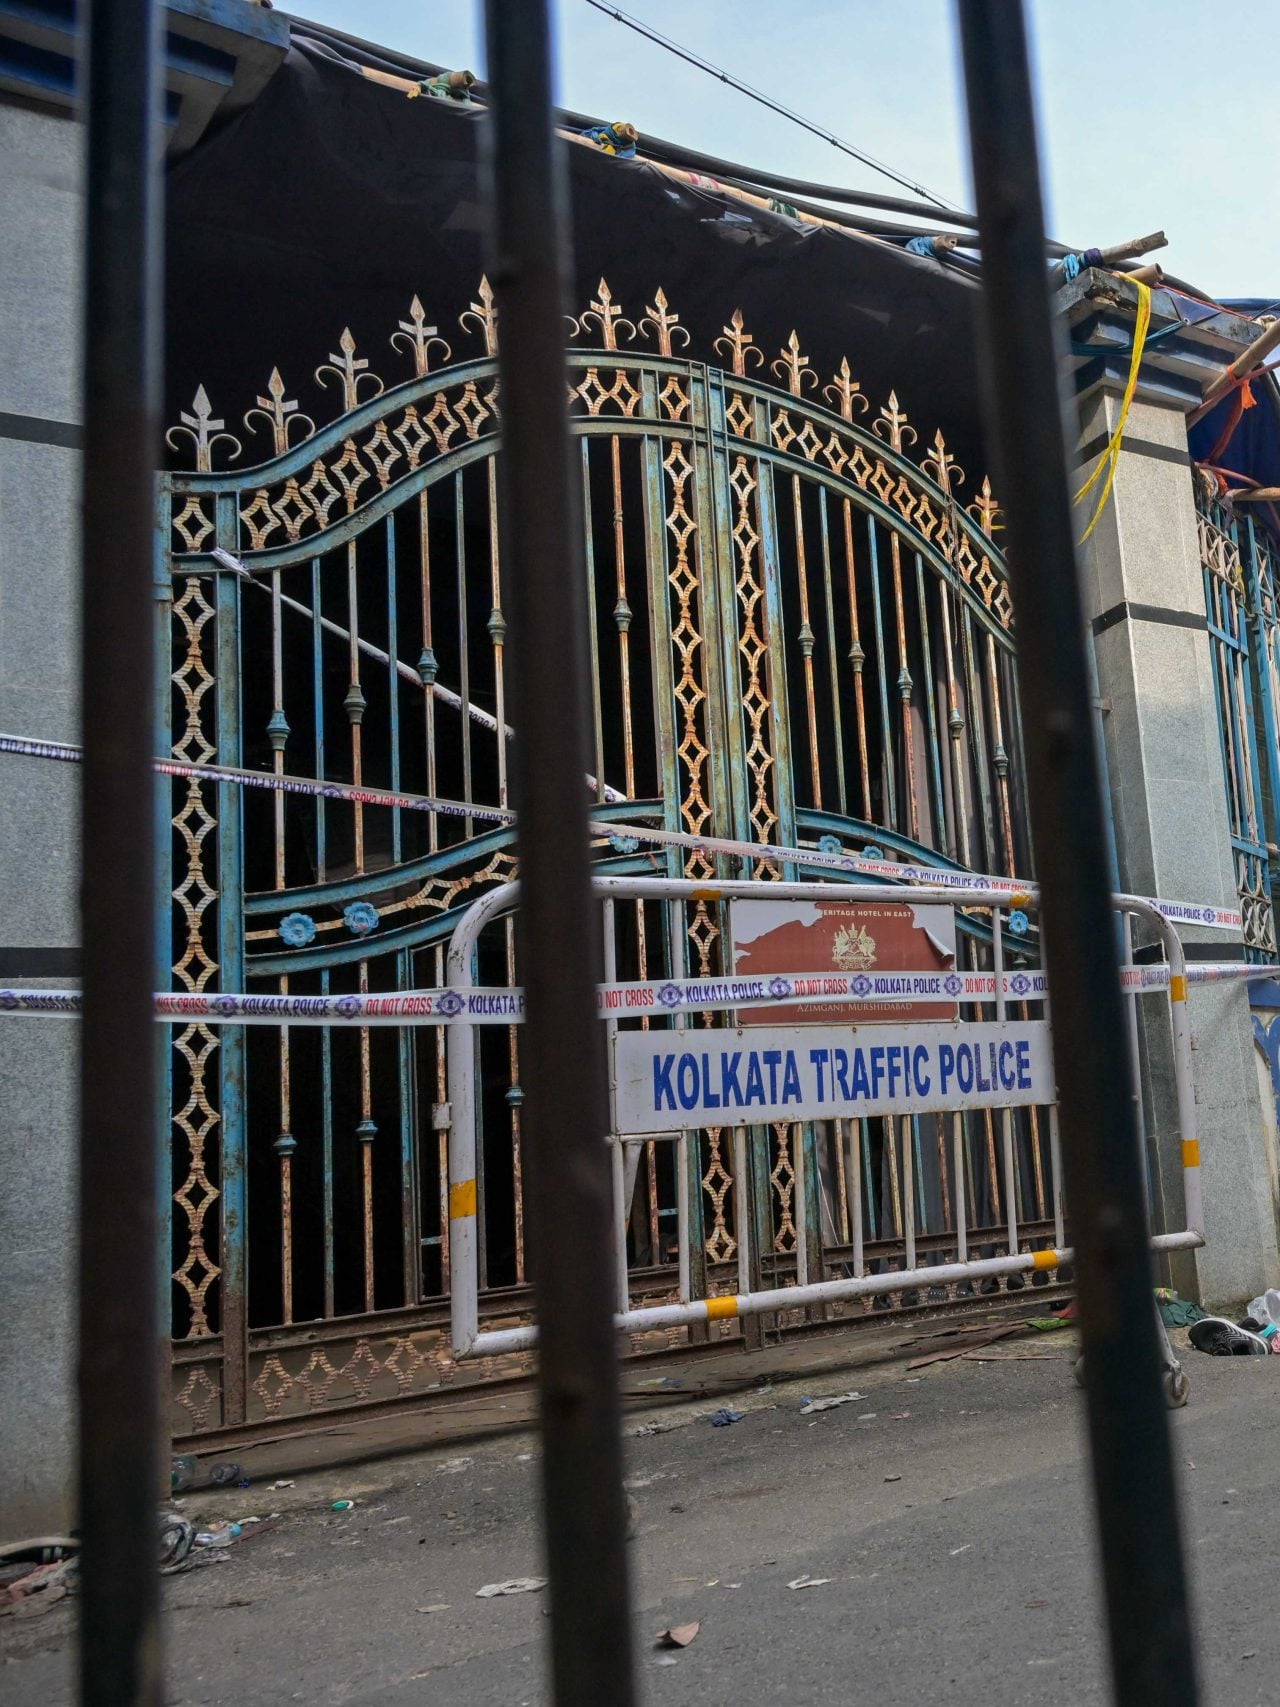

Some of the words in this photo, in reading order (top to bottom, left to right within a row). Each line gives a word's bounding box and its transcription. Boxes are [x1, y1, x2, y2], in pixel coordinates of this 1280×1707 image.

[823, 909, 855, 917] ERITAGE
[686, 983, 732, 1003] KOLKATA
[733, 981, 765, 1000] POLICE
[794, 980, 804, 996] DO
[807, 979, 821, 995] NOT
[823, 978, 848, 994] CROSS
[874, 978, 912, 994] KOLKATA
[913, 978, 940, 993] POLICE
[965, 978, 974, 992] DO
[974, 978, 986, 992] NOT
[987, 978, 1008, 992] CRS
[177, 997, 209, 1014] CROSS
[242, 998, 292, 1016] KOLKATA
[293, 998, 330, 1016] POLICE
[366, 998, 380, 1016] DO
[382, 997, 401, 1016] NOT
[402, 996, 433, 1015] CROSS
[469, 995, 516, 1014] KOLKATA
[605, 990, 623, 1008] NOT
[625, 988, 654, 1007] CROSS
[848, 1002, 913, 1011] MURSHIDABAD
[653, 1049, 802, 1112] KOLKATA
[810, 1044, 931, 1103] TRAFFIC
[939, 1040, 1032, 1095] POLICE
